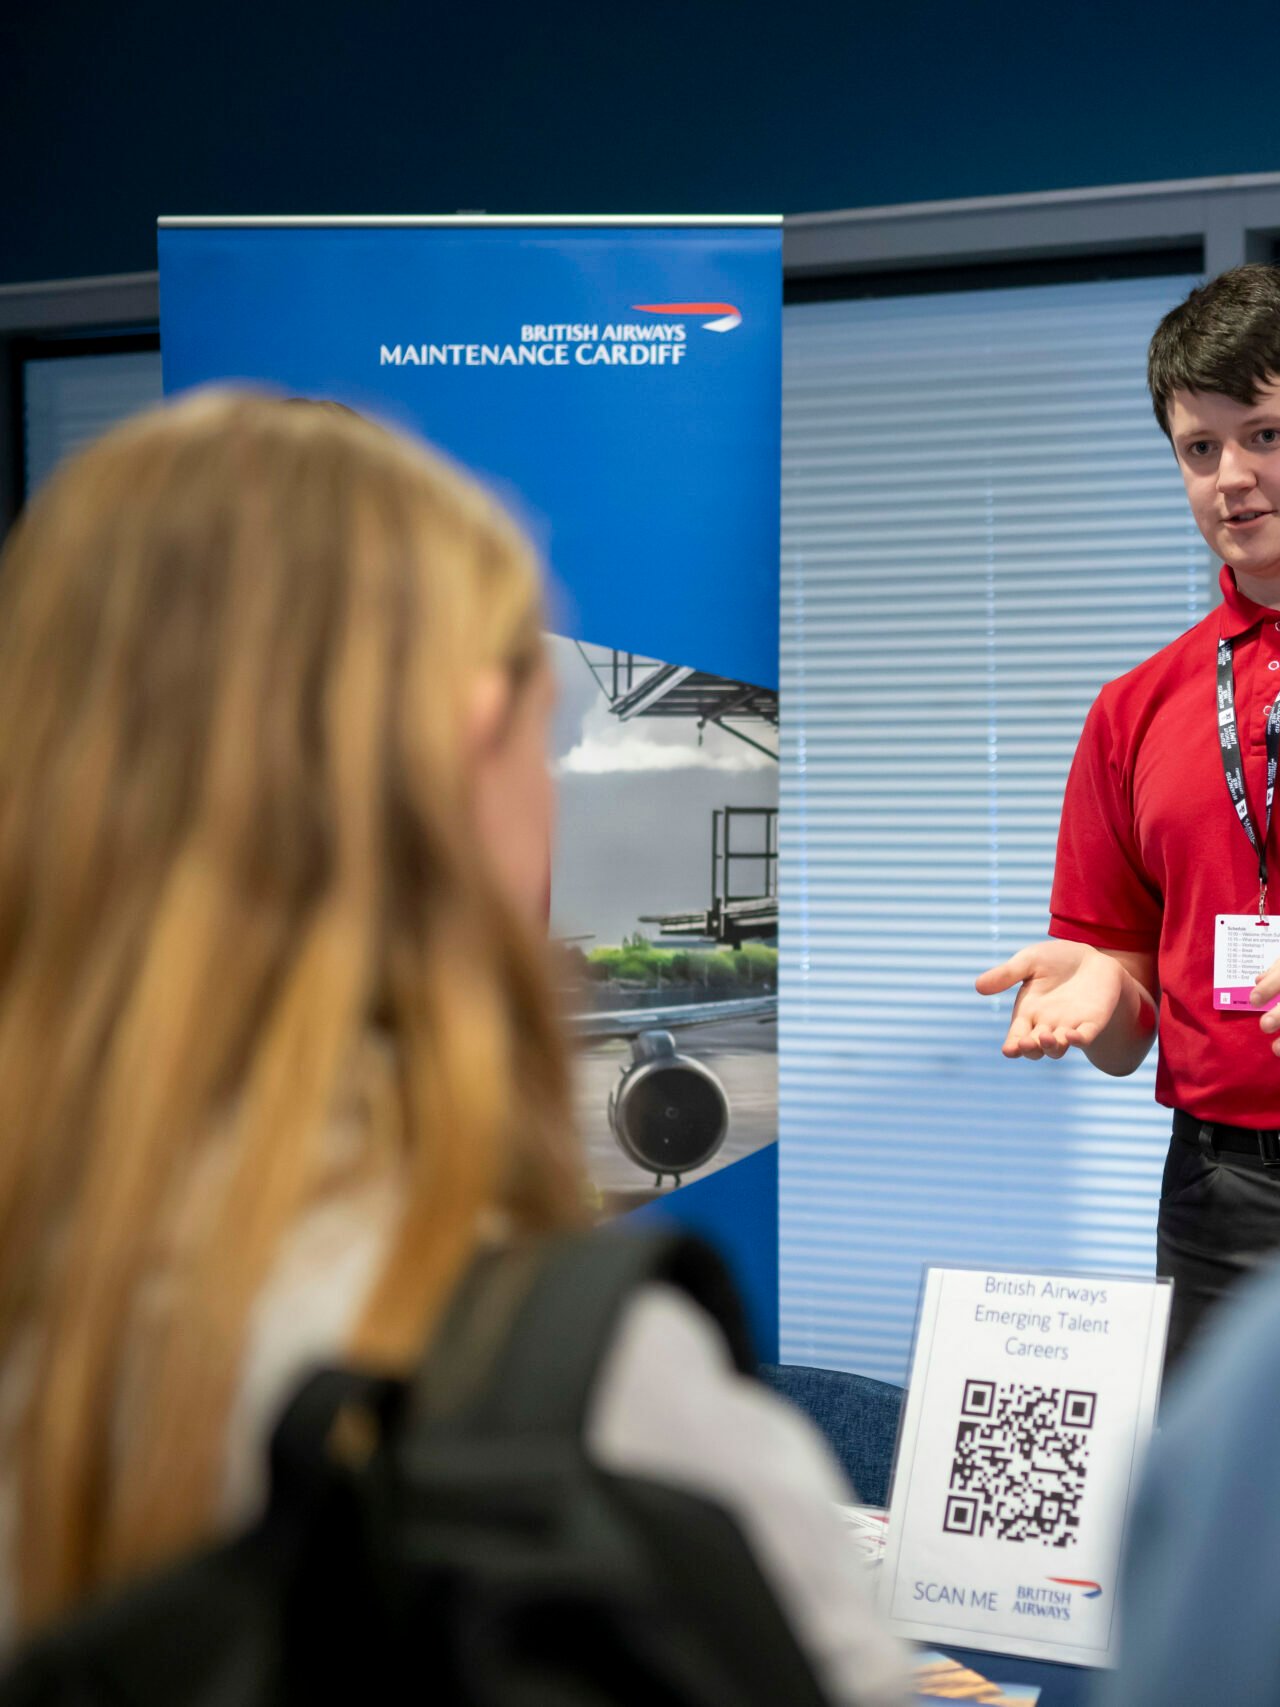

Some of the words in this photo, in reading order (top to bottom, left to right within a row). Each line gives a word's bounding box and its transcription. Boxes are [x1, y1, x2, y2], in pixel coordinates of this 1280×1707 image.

[520, 324, 599, 342] BRITISH
[601, 324, 687, 342] AIRWAYS
[379, 344, 569, 366] MAINTENANCE
[574, 344, 688, 366] CARDIFF
[984, 1276, 1036, 1297] British
[1039, 1282, 1108, 1304] Airways
[973, 1304, 1051, 1333] Emerging
[1057, 1311, 1109, 1334] Talent
[1004, 1336, 1069, 1361] Careers
[913, 1581, 966, 1606] SCAN
[969, 1590, 999, 1612] ME
[1016, 1585, 1072, 1605] BRITISH
[1011, 1600, 1071, 1622] AIRWAYS
